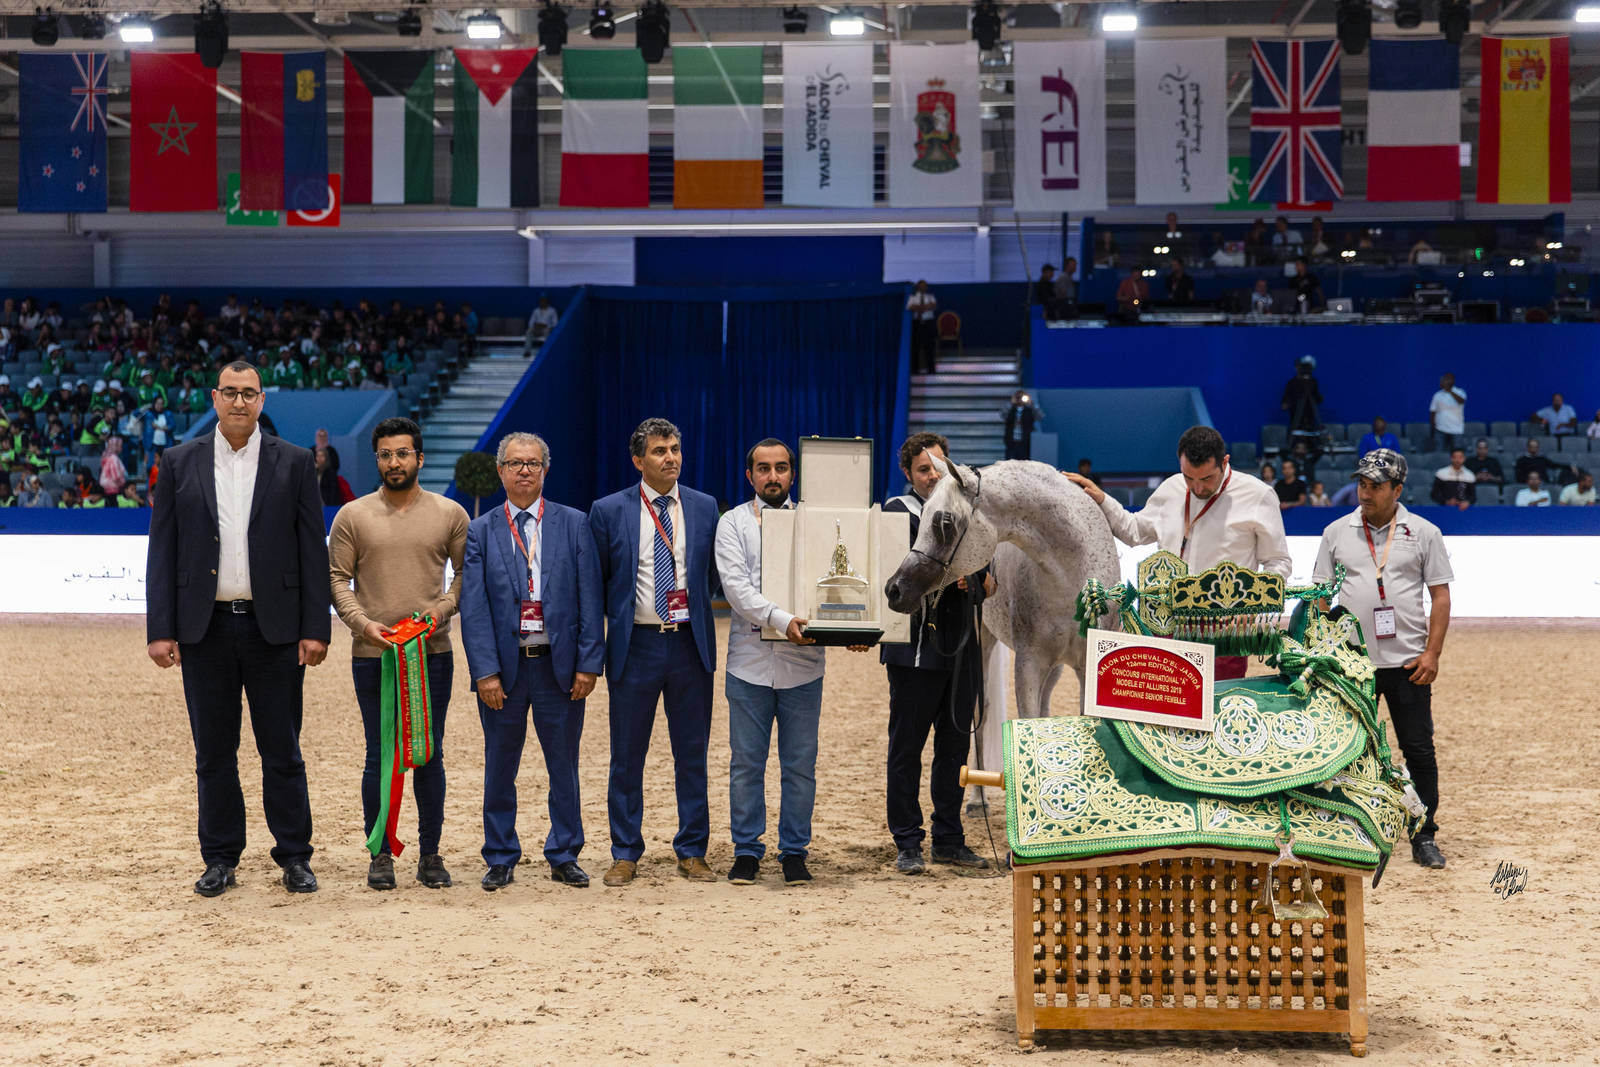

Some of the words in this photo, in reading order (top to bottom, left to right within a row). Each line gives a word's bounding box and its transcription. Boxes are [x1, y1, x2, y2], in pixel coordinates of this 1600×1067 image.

[805, 101, 817, 152] JADIDA
[1040, 67, 1080, 191] FEI
[1175, 84, 1189, 138] معرض
[818, 138, 831, 190] CHEVAL
[1175, 139, 1190, 193] الفرس
[1098, 658, 1119, 676] SALON
[1119, 654, 1131, 662] DU
[1132, 653, 1162, 662] CHEVAL
[1163, 658, 1178, 669] D'EL
[1179, 667, 1201, 690] JADIDA
[1112, 668, 1140, 679] CONCOURS
[1141, 672, 1179, 685] INTERNATIONAL
[1138, 681, 1145, 689] ET
[1146, 682, 1169, 693] ALLURES
[1147, 661, 1175, 674] EDITION
[1112, 687, 1145, 700] CHAMPIONNE
[1145, 692, 1163, 702] SENIOR
[1164, 695, 1186, 705] FEMELLE
